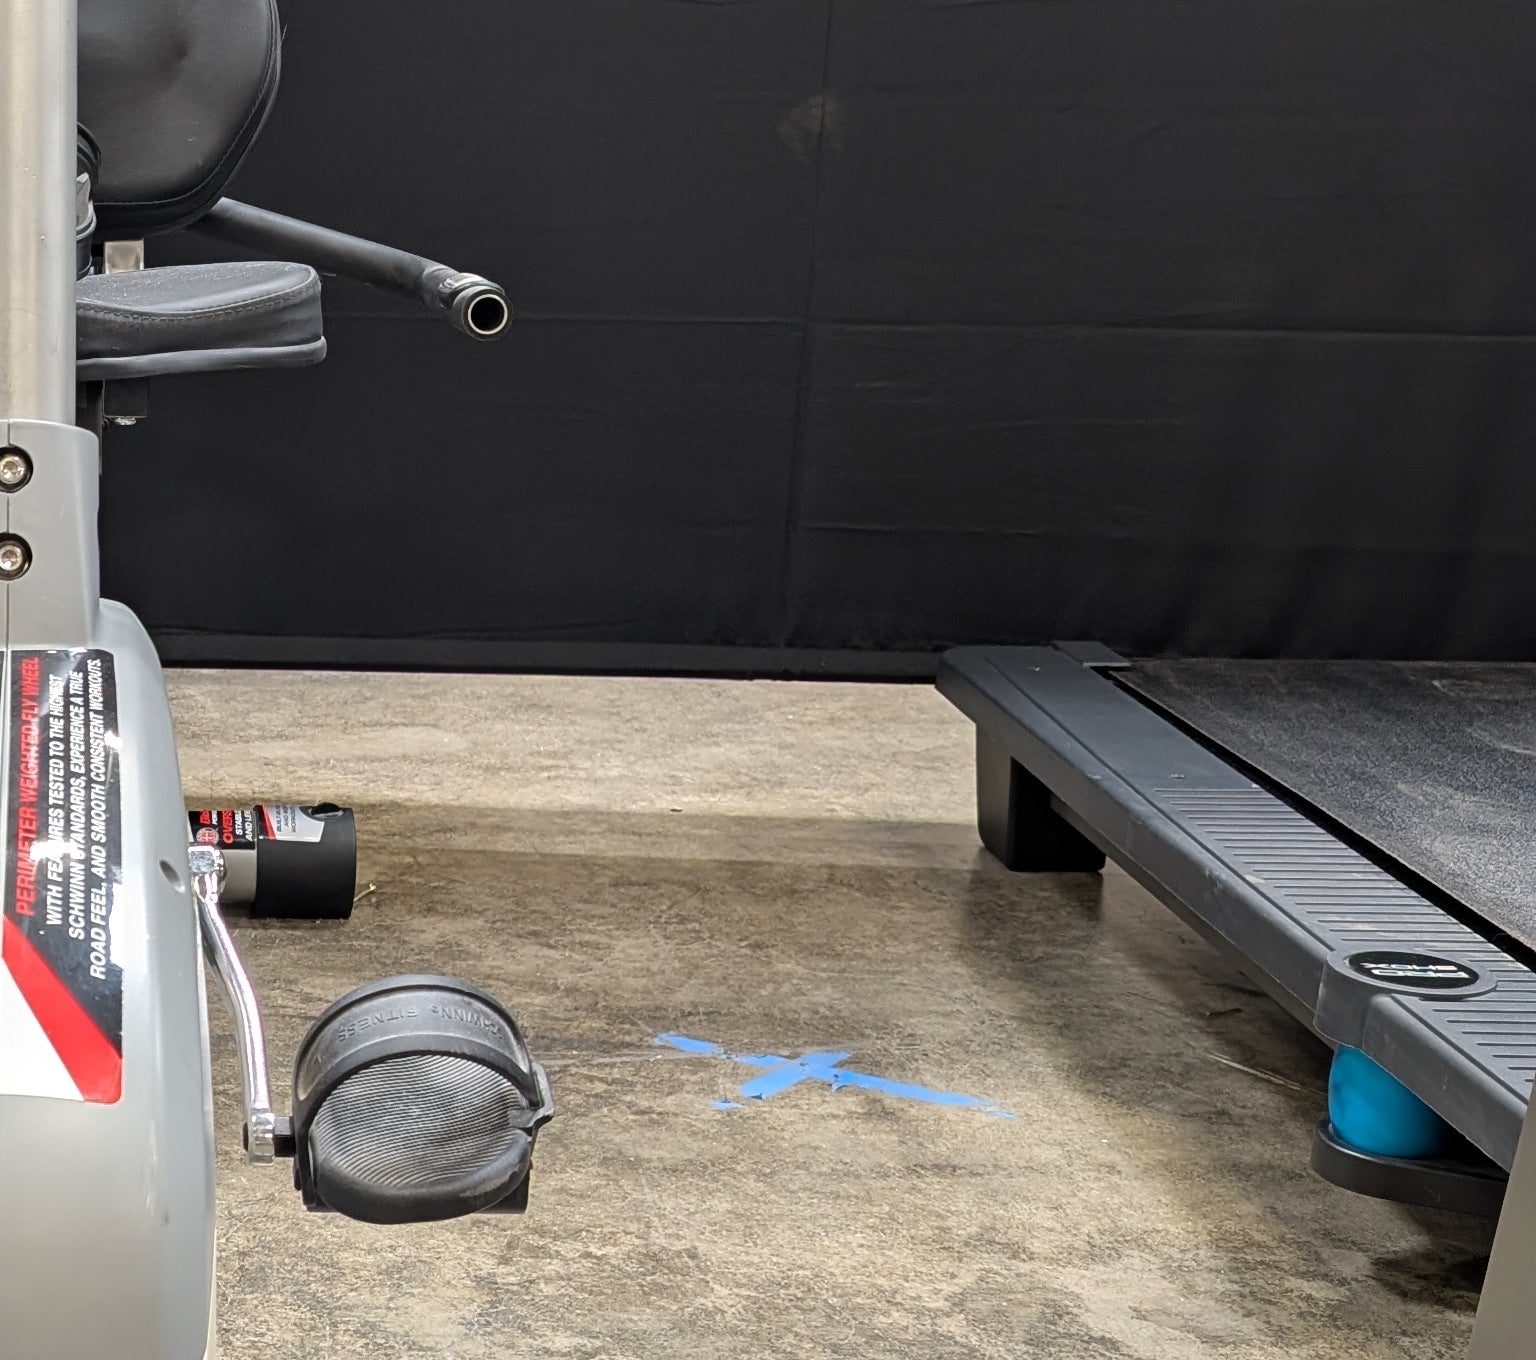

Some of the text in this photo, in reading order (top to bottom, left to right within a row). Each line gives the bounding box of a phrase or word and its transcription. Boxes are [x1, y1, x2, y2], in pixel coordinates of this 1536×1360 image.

[69, 671, 84, 695] TRUE
[70, 697, 84, 705] A
[87, 659, 104, 710] WORKOUTS.
[70, 705, 86, 773] EXPERIENCE
[89, 711, 106, 782] CONSISTENT
[16, 657, 41, 916] PERIMETER WEIGHTED FLY WHEEL
[46, 674, 64, 925] WITH FEAURES TESTED TO THE HIGHEST
[90, 784, 107, 843] SMOOTH
[245, 822, 253, 841] AND
[91, 846, 106, 879] AND
[68, 862, 85, 940] SCHWINN
[89, 928, 106, 980] ROAD
[337, 1007, 419, 1042] FITNESS
